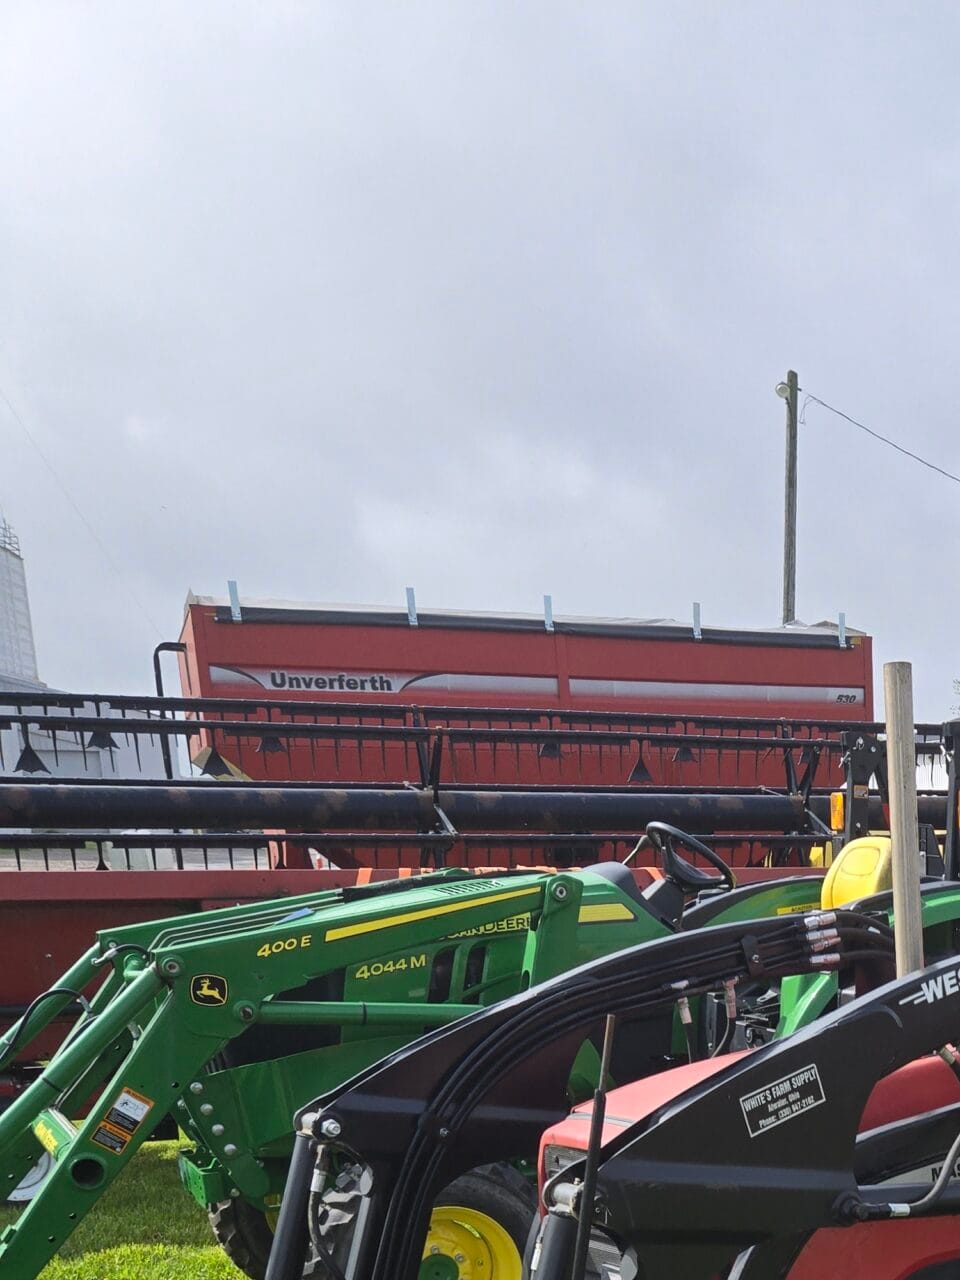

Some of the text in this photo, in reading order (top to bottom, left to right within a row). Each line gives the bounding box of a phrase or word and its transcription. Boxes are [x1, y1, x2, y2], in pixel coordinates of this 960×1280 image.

[270, 672, 393, 692] Unverferth
[836, 694, 857, 704] 530
[256, 934, 312, 958] 400 E
[355, 953, 426, 980] 4044 M
[743, 1068, 816, 1112] WHITE'S FARM SUPPLY
[758, 1115, 778, 1128] Phone:
